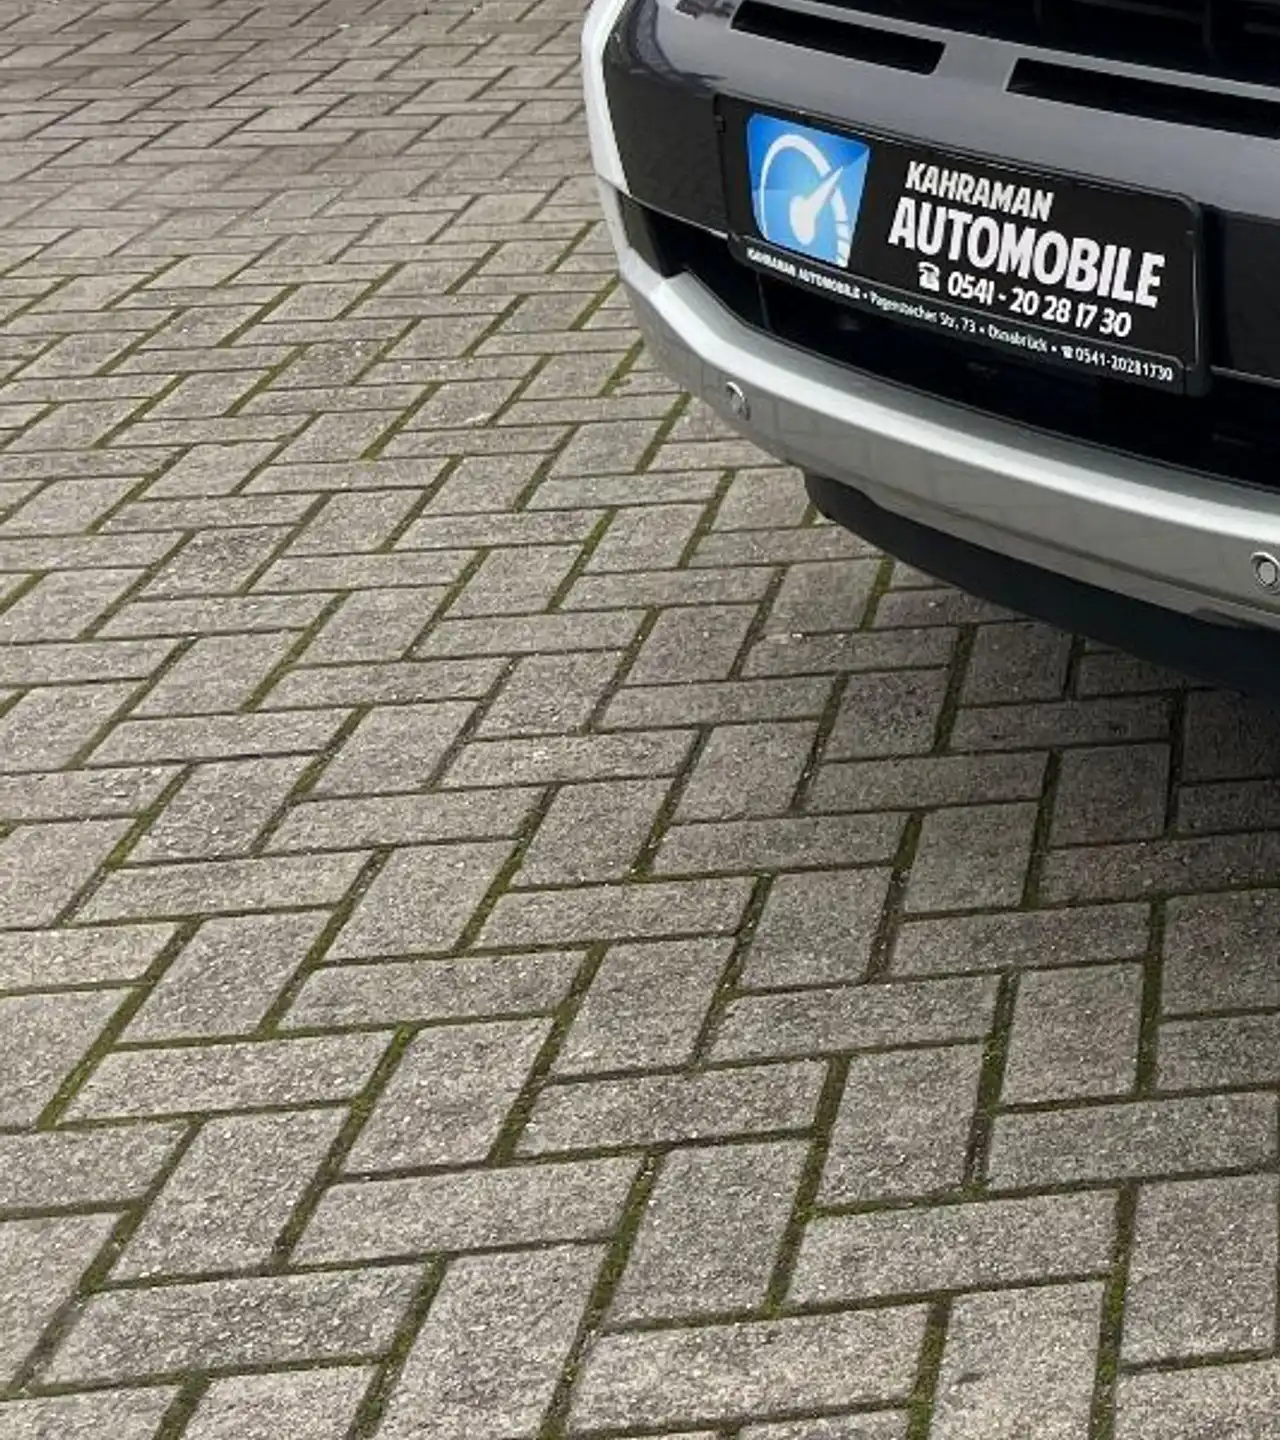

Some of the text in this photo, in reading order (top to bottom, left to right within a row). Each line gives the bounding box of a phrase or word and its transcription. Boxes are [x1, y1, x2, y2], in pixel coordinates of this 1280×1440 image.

[904, 160, 1055, 223] KAHRAMAN
[887, 196, 1166, 309] AUTOMOBILE
[947, 271, 995, 306] 0541
[1009, 287, 1040, 317] 20
[1042, 295, 1071, 324] 28
[1075, 302, 1098, 330] 17
[1099, 308, 1132, 338] 30
[960, 316, 976, 333] 73
